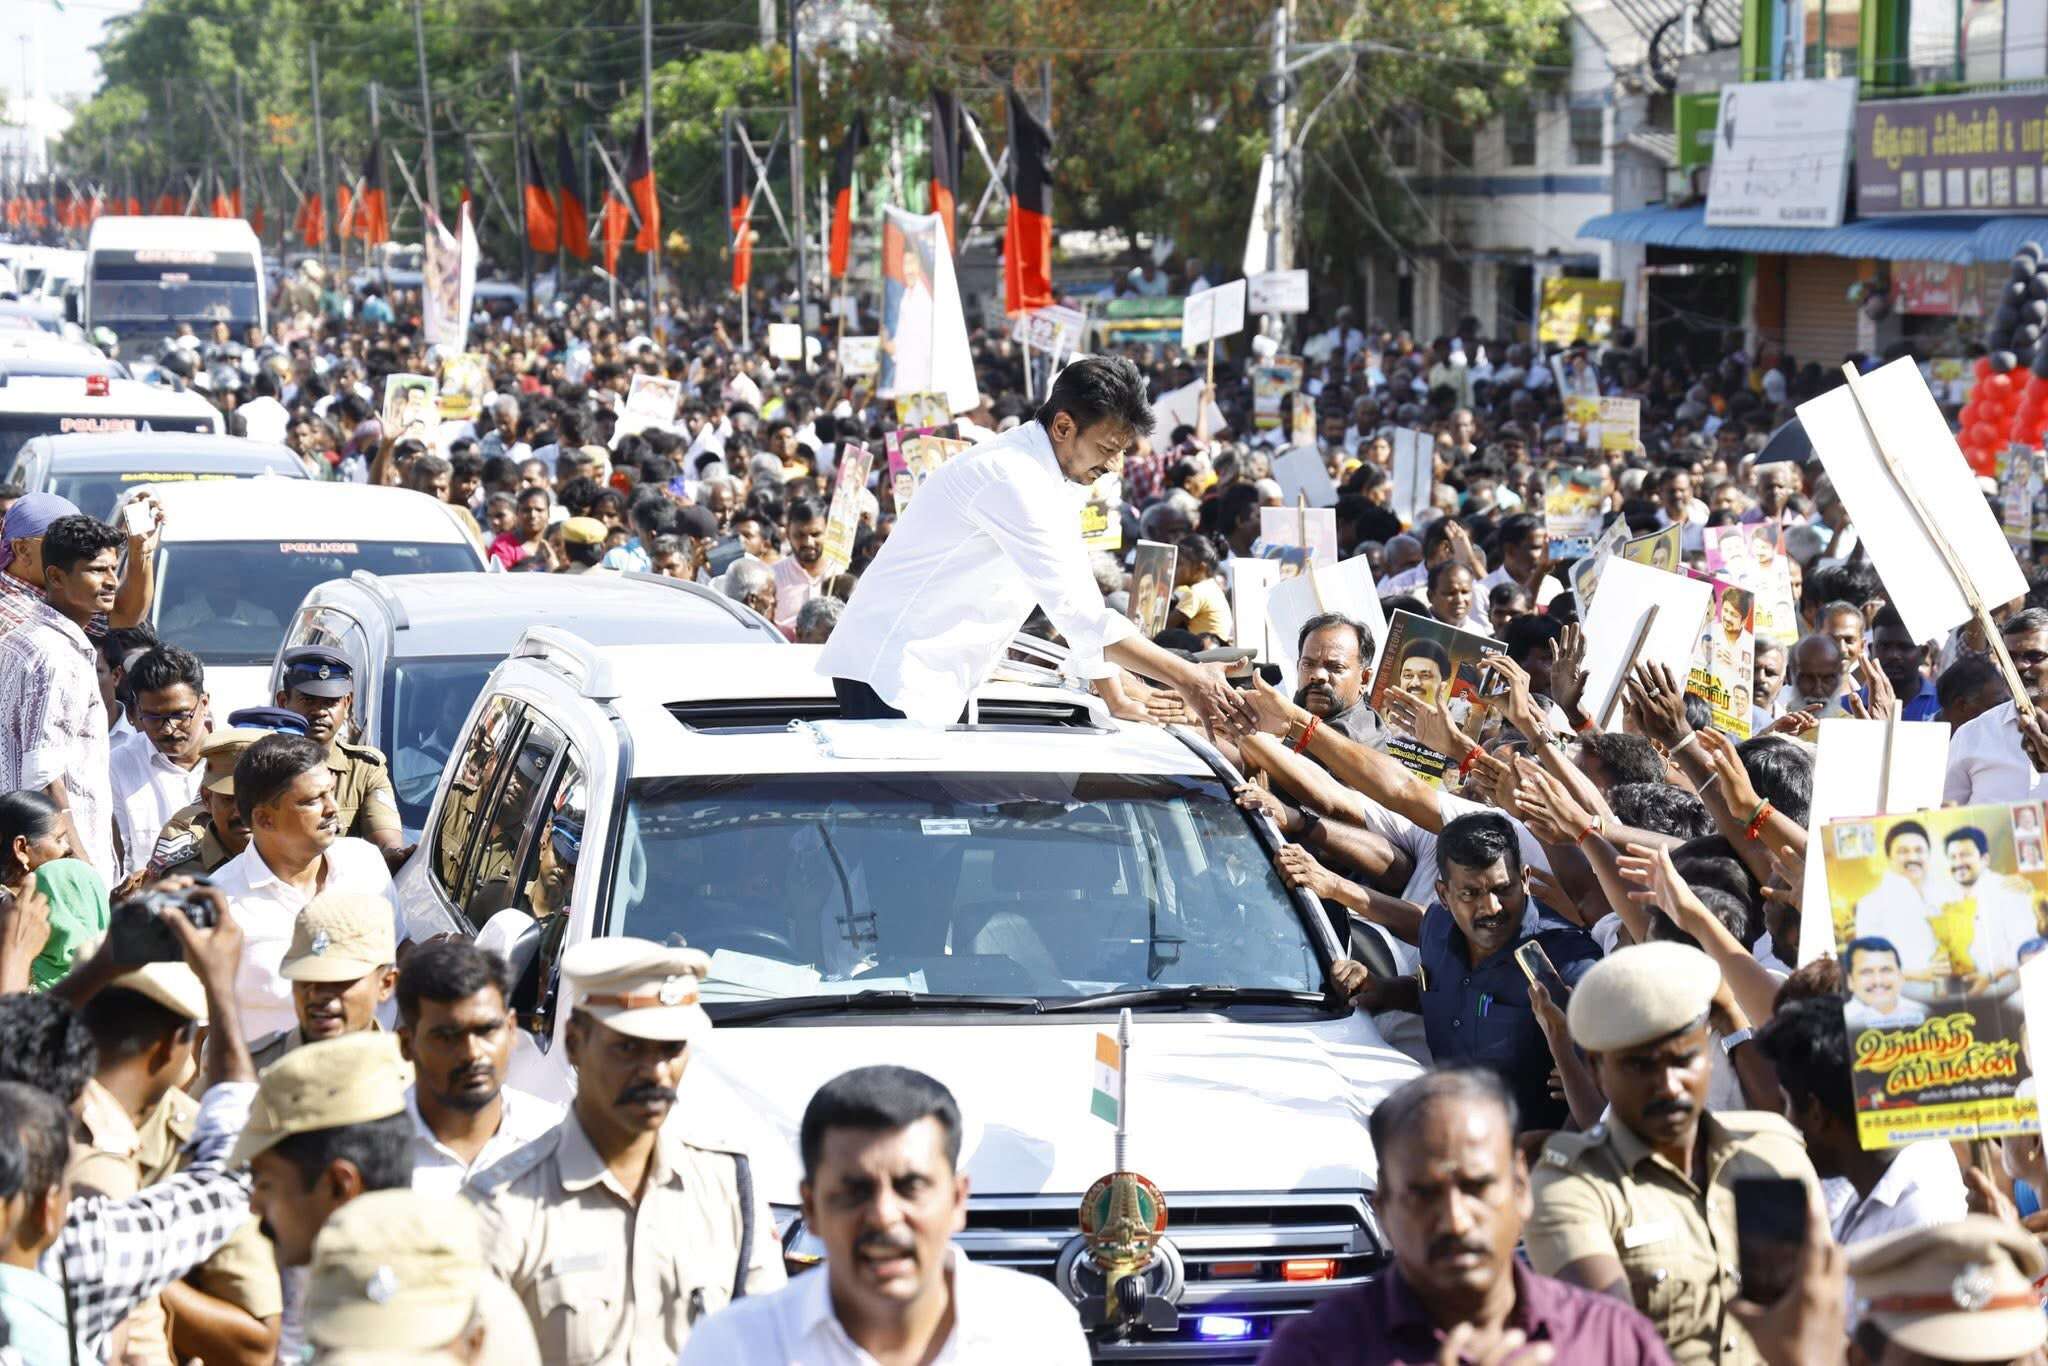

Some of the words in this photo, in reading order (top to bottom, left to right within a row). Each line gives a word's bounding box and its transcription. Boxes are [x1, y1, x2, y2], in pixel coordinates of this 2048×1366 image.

[60, 417, 136, 433] POLICE
[280, 543, 358, 553] POLICE
[1854, 1013, 1976, 1072] உதயநிதி
[1886, 1039, 2020, 1095] ஸ்டாலின்
